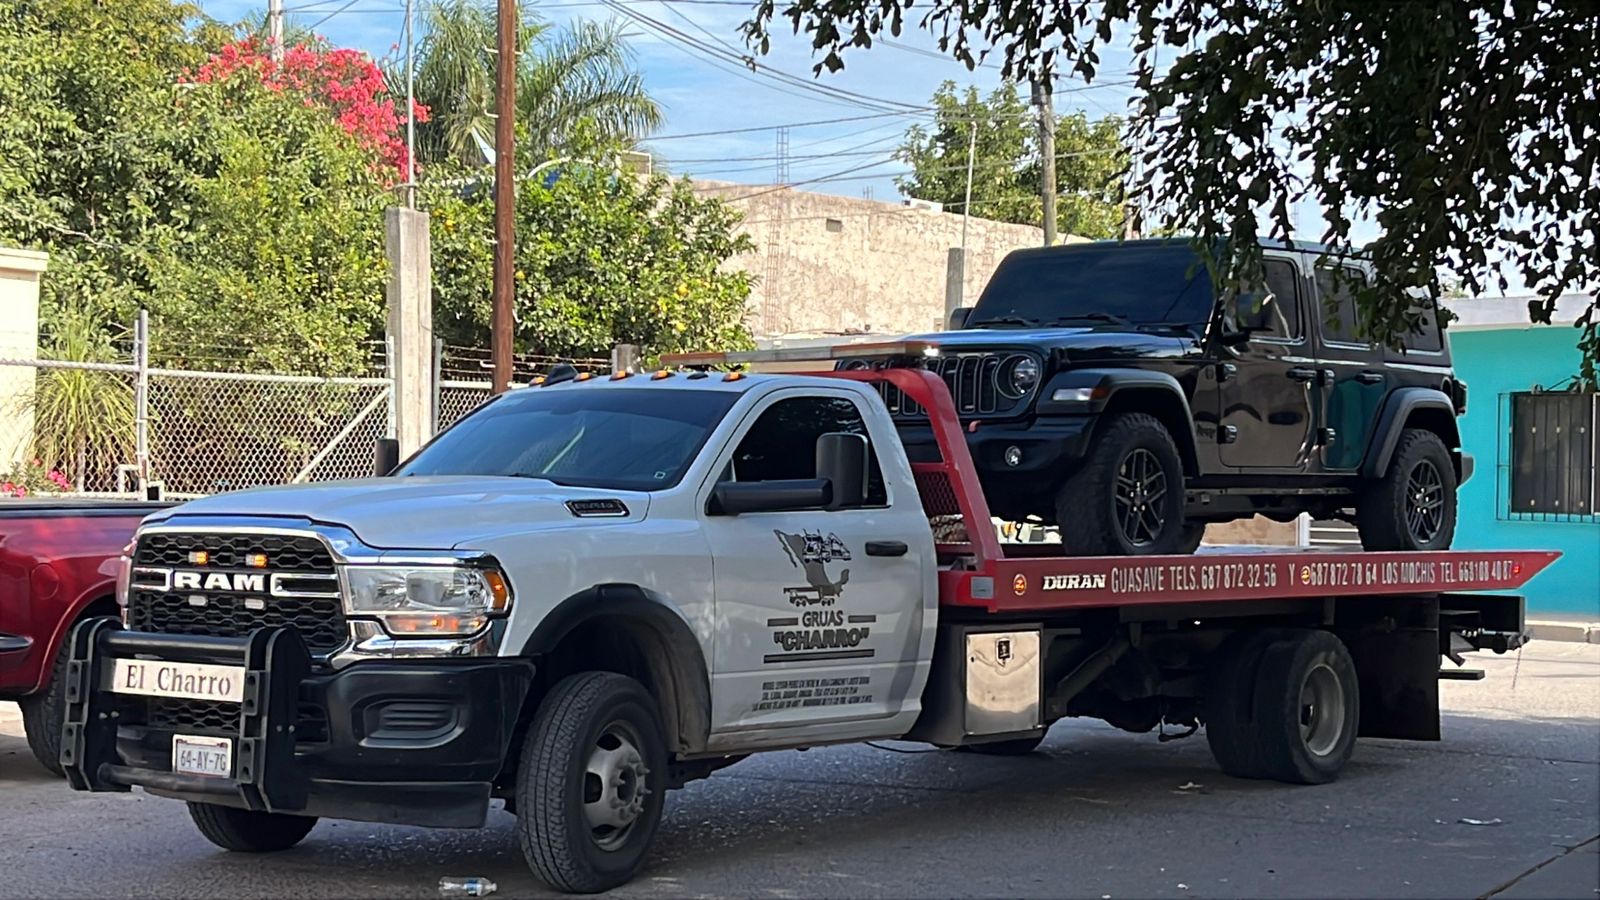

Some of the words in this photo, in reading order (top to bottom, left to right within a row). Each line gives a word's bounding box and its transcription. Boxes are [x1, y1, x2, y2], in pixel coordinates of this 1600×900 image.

[174, 572, 265, 591] RAM
[1043, 574, 1106, 590] DURAN
[1111, 566, 1164, 593] GUASAVE
[1169, 565, 1199, 590] TELS.
[1201, 565, 1221, 590] 687
[1224, 563, 1244, 588] 872
[1247, 564, 1260, 588] 32
[1264, 563, 1277, 587] 56
[1289, 563, 1296, 586] Y
[1311, 562, 1329, 586] 687
[1330, 563, 1348, 586] 872
[1351, 562, 1363, 585] 78
[1366, 562, 1377, 585] 64
[1382, 562, 1398, 585] LOS
[1401, 561, 1436, 584] MOCHIS
[802, 610, 844, 628] GRUAS
[126, 664, 145, 690] El
[157, 666, 231, 696] Charro
[180, 749, 227, 772] 64-AY-7G
